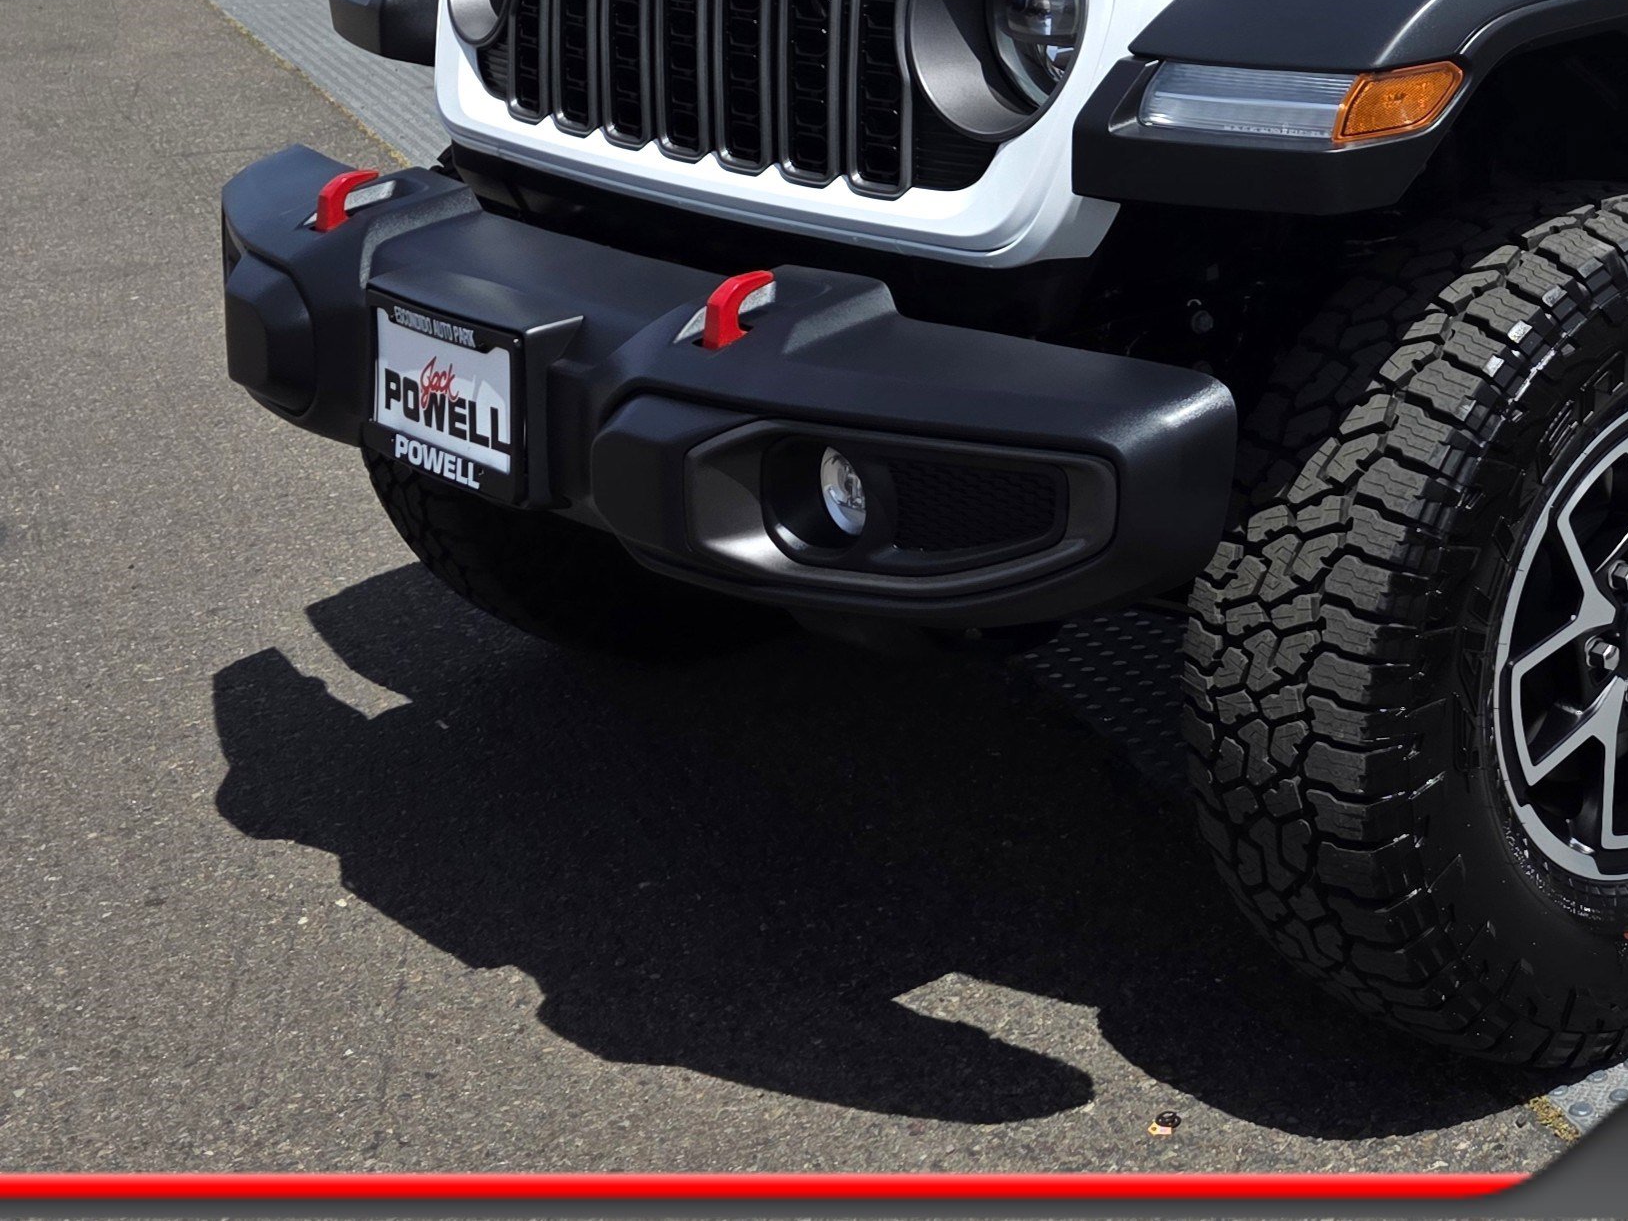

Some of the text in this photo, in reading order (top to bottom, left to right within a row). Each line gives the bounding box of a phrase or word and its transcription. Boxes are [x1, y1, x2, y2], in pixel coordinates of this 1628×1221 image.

[393, 305, 476, 348] ESCONDIDO AUTO PARK
[420, 356, 459, 409] Jack
[384, 367, 511, 456] POWELL
[394, 433, 480, 490] POWELL
